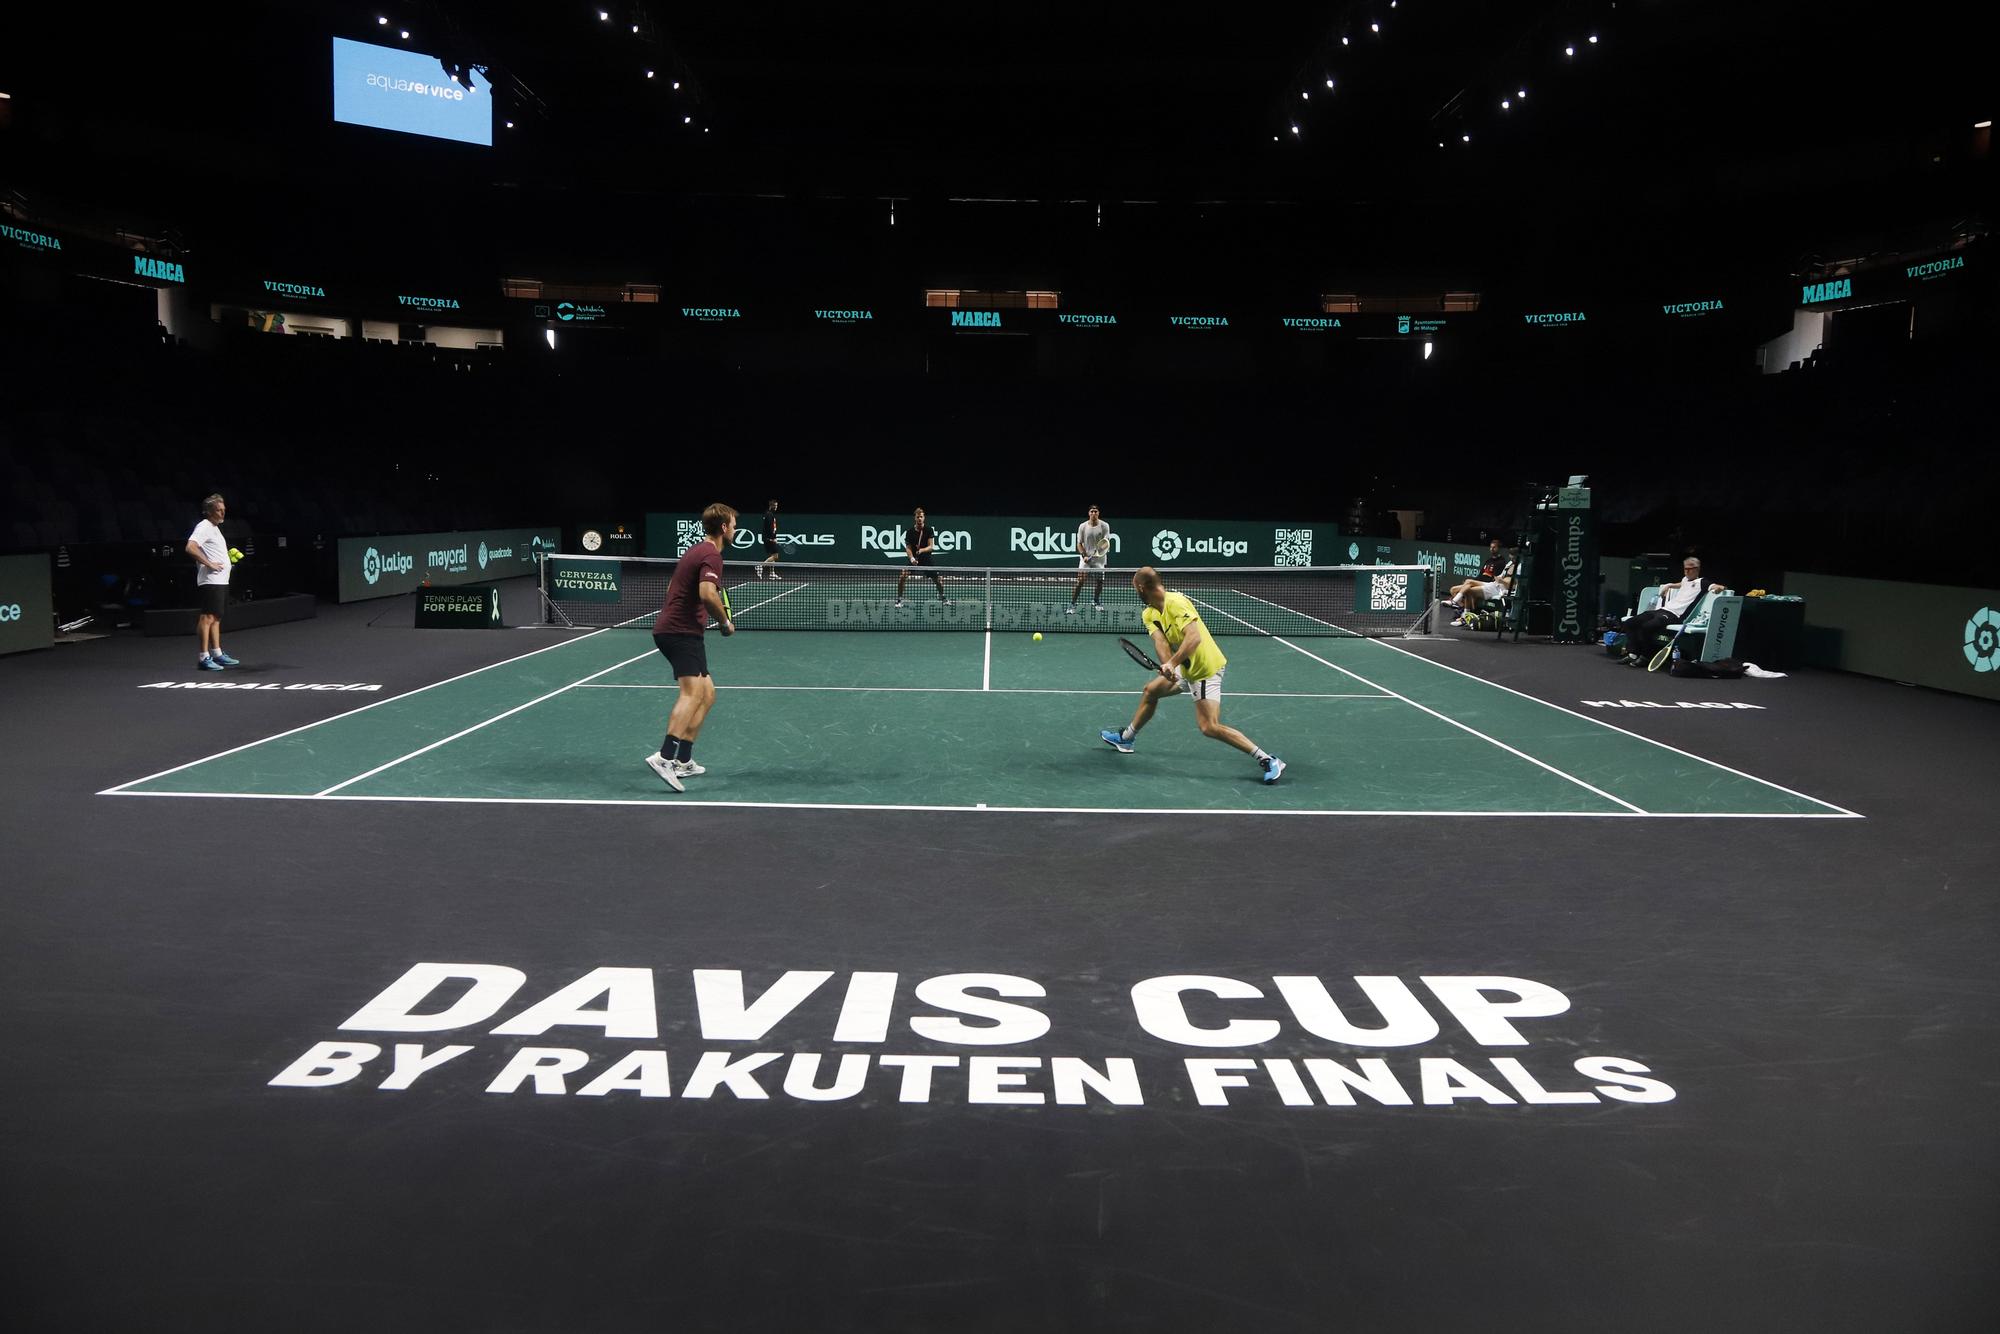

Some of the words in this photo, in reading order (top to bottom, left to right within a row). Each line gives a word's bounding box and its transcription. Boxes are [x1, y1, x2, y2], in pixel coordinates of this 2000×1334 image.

[367, 73, 463, 101] aquaservice
[0, 224, 62, 250] VICTORIA
[134, 256, 184, 283] MARCA
[1906, 256, 1965, 279] VICTORIA
[264, 280, 325, 297] VICTORIA
[1802, 278, 1853, 305] MARCA
[398, 296, 460, 309] VICTORIA
[1663, 299, 1724, 315] VICTORIA
[682, 308, 741, 318] VICTORIA
[815, 310, 874, 320] VICTORIA
[952, 311, 1001, 327] MARCA
[1059, 314, 1118, 325] VICTORIA
[1525, 312, 1586, 324] VICTORIA
[1170, 317, 1229, 326] VICTORIA
[1282, 318, 1341, 328] VICTORIA
[861, 524, 972, 551] Rakten
[1010, 526, 1121, 553] Rakun
[1186, 535, 1248, 558] LaLiga
[381, 552, 413, 575] LaLiga
[428, 543, 467, 571] mayoral
[560, 570, 613, 581] CERVEZAS
[1453, 565, 1464, 576] FAN
[555, 579, 618, 591] VICTORIA
[1563, 572, 1581, 588] &
[425, 595, 455, 603] TENNIS
[457, 595, 483, 604] PLAYS
[424, 603, 445, 612] FOR
[448, 603, 483, 613] PEACE
[826, 600, 917, 624] DAVIS
[922, 601, 984, 625] CUP
[338, 962, 1051, 1046] DAVIS
[1131, 975, 1571, 1048] CUP
[267, 1041, 475, 1091] BY
[485, 1046, 1144, 1106] RAKUTEN
[1184, 1055, 1677, 1107] FINALS
